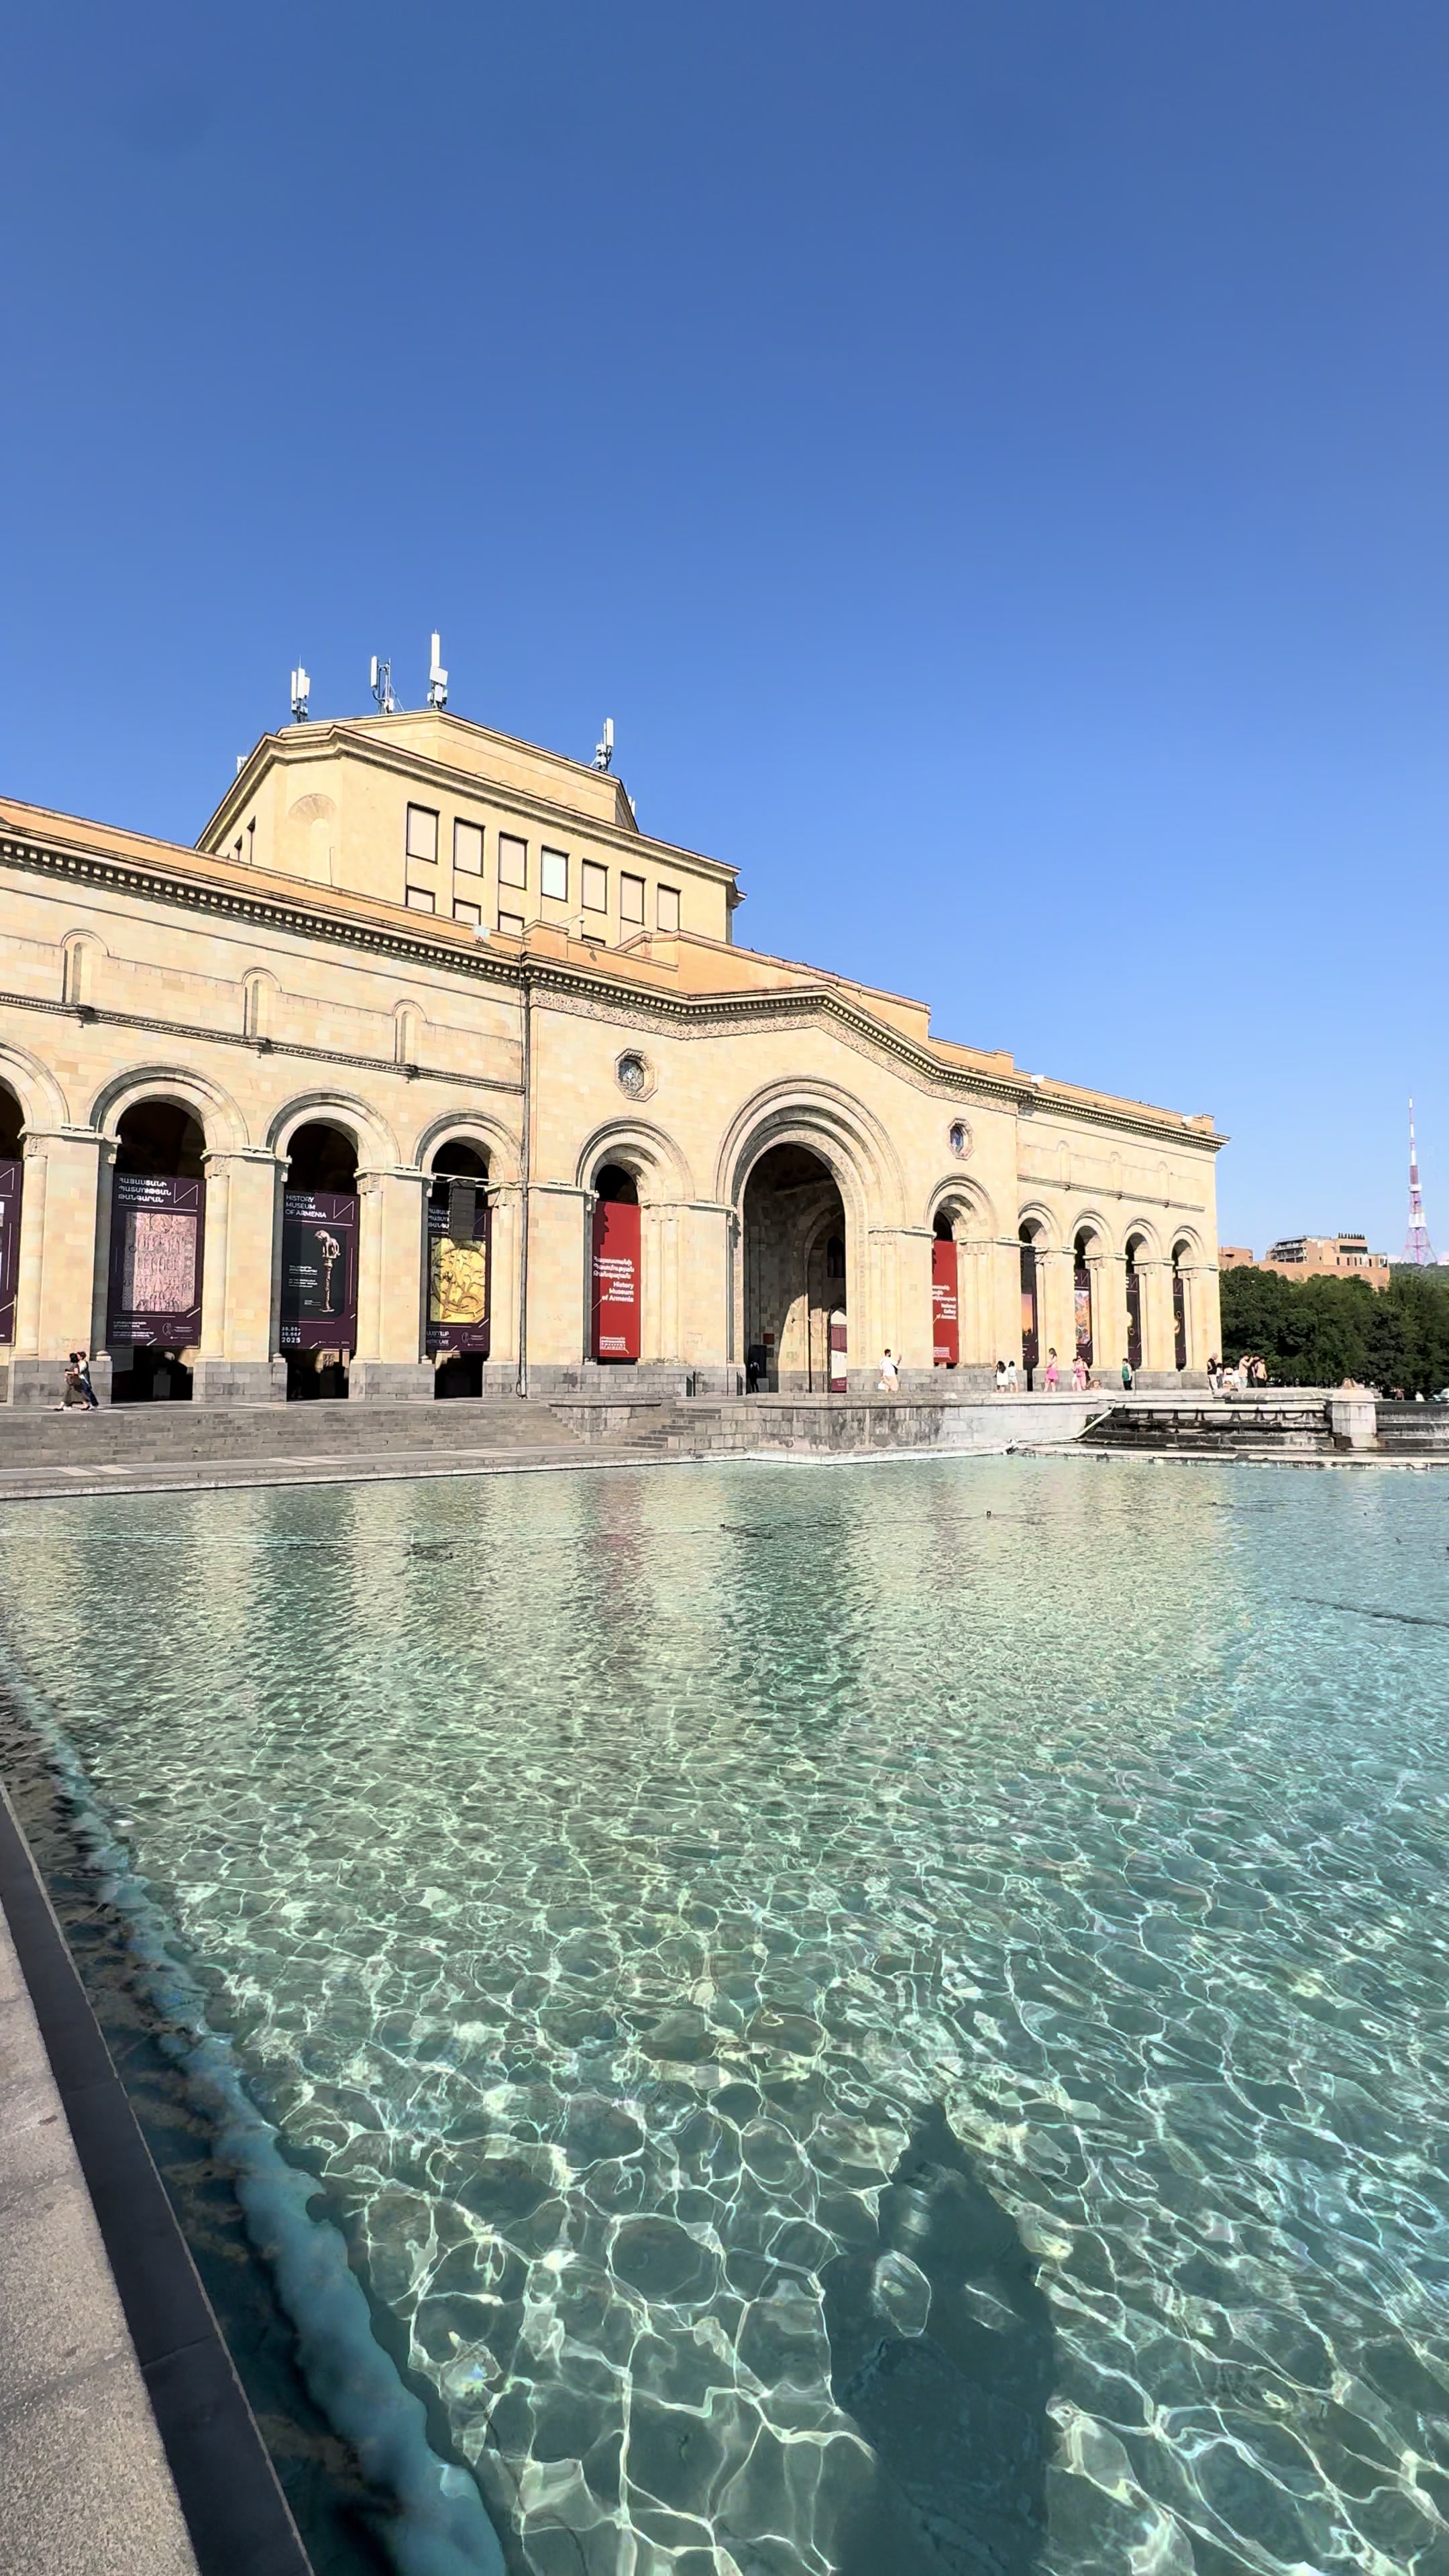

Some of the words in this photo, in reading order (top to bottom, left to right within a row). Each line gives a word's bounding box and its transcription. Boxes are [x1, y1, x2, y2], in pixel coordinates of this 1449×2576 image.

[286, 1195, 315, 1203] HISTORY
[286, 1201, 316, 1210] MUSEUM
[295, 1210, 327, 1218] ARMENIA
[613, 1281, 634, 1289] History
[609, 1295, 634, 1303] Armenia
